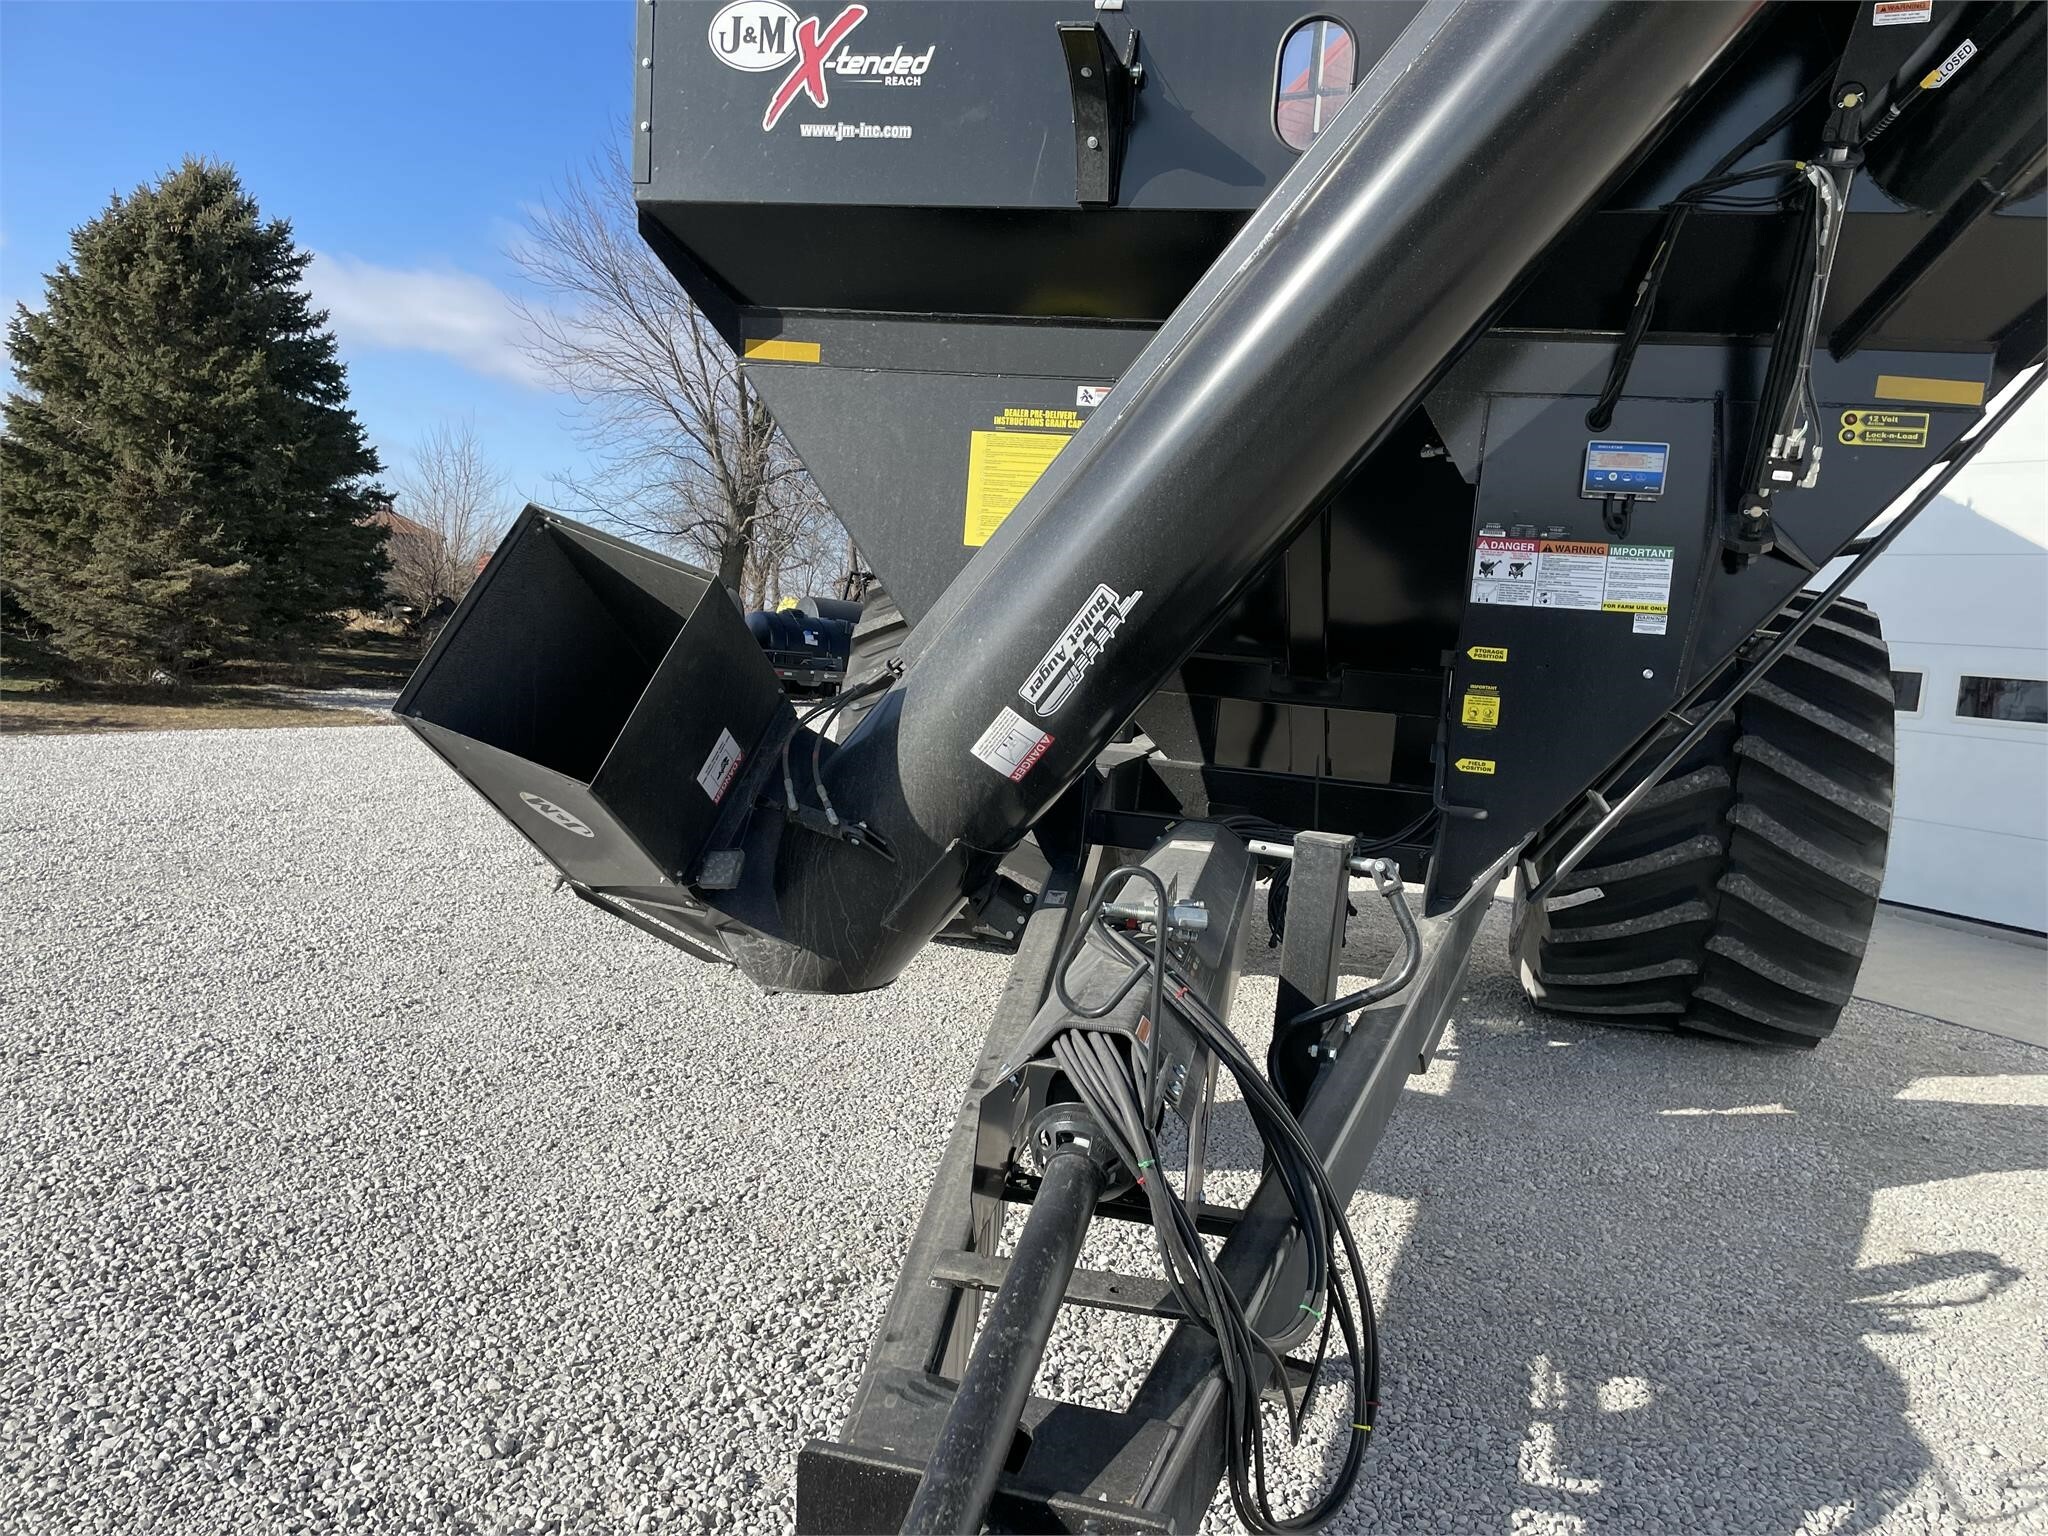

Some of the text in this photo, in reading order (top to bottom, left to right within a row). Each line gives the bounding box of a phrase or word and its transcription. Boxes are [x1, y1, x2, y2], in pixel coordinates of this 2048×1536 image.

[719, 15, 788, 54] J&M
[884, 76, 922, 86] REACH
[800, 122, 912, 141] www.jm-inc.com
[1004, 408, 1077, 420] DEALER PRE-DELIVERY
[1881, 415, 1899, 423] Volt
[993, 416, 1044, 427] INSTRUCTIONS
[1045, 419, 1066, 428] GRAIN
[1865, 431, 1919, 440] Lock-n-Load
[1490, 540, 1535, 551] DANGER
[1555, 544, 1605, 555] WARNING
[1610, 546, 1673, 558] IMPORTANT
[1029, 592, 1110, 698] Bullet Auger
[1012, 742, 1046, 781] DANGER
